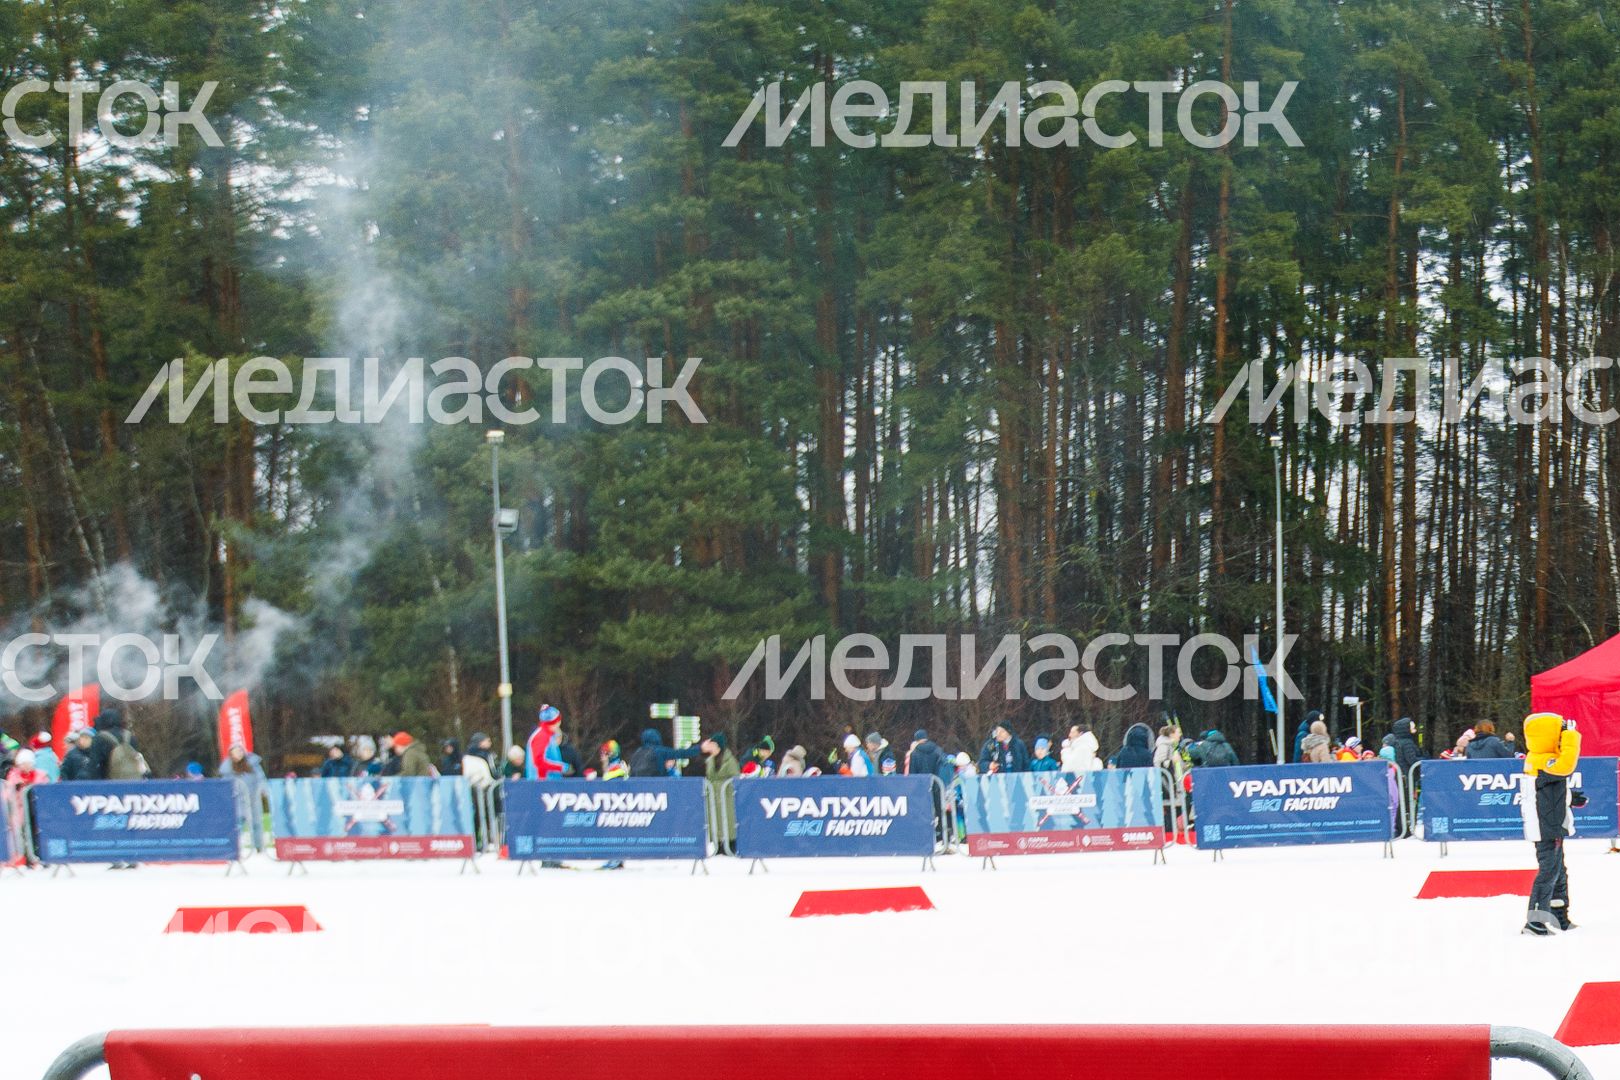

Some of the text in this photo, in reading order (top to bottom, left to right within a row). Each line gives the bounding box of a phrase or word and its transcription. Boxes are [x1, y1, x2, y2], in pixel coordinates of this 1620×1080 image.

[1229, 776, 1352, 797] УРАЛХИМ
[71, 793, 199, 815] УРАЛХИМ
[541, 792, 667, 812] УРАЛХИМ
[760, 796, 907, 819] УРАЛХИМ
[1249, 796, 1339, 812] SKI FACTORY
[1478, 792, 1511, 806] SKI
[597, 812, 655, 827] FACTORY
[784, 819, 893, 836] SKI FACTORY
